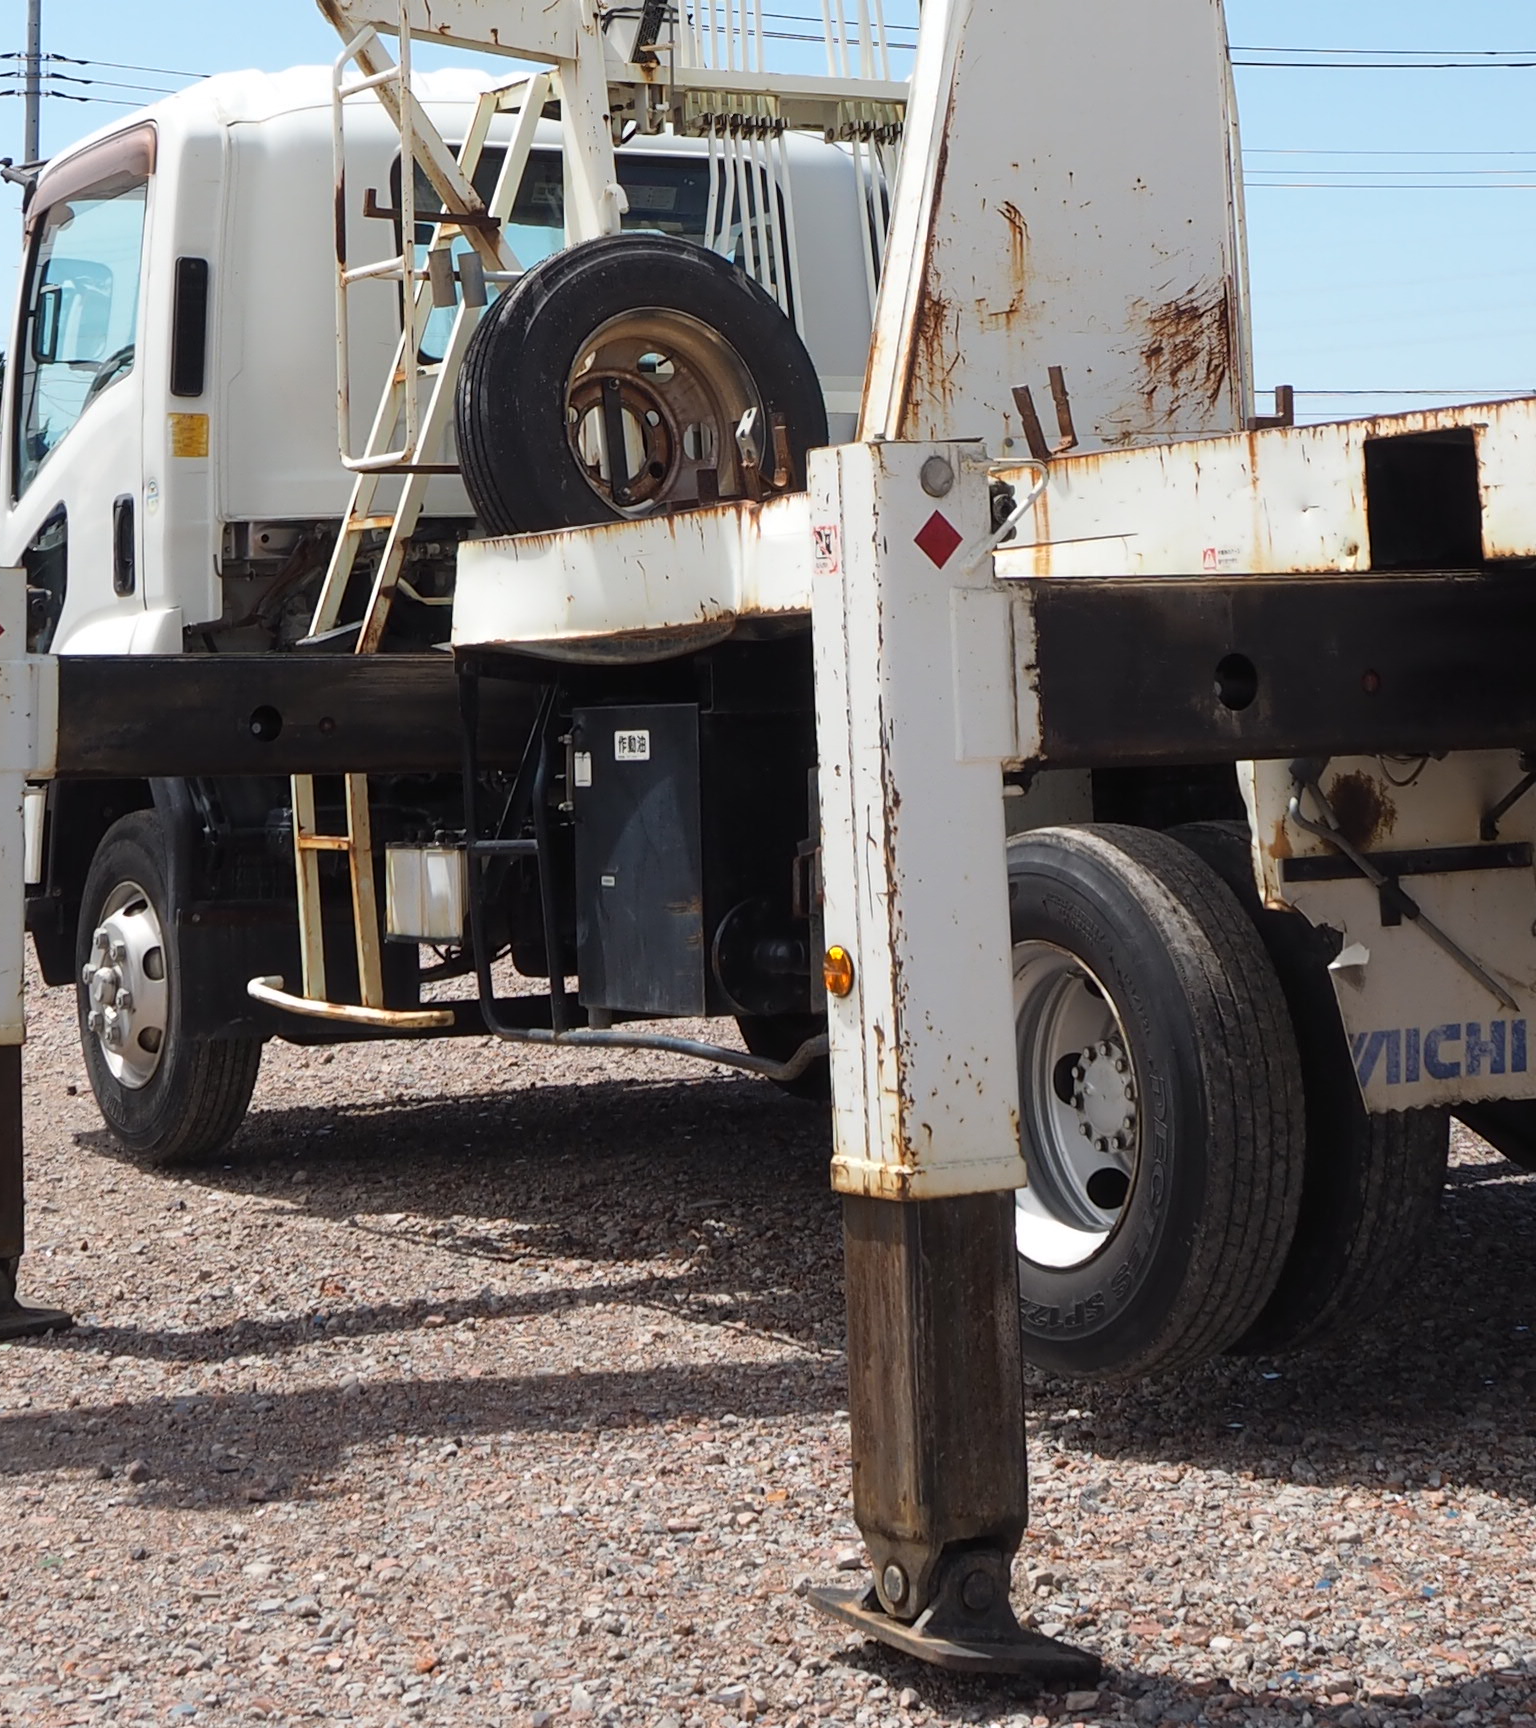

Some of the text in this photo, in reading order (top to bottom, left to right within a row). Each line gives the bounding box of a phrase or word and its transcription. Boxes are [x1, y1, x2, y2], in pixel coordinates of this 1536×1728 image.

[618, 735, 647, 754] 作動油
[1356, 1019, 1528, 1088] AICHI
